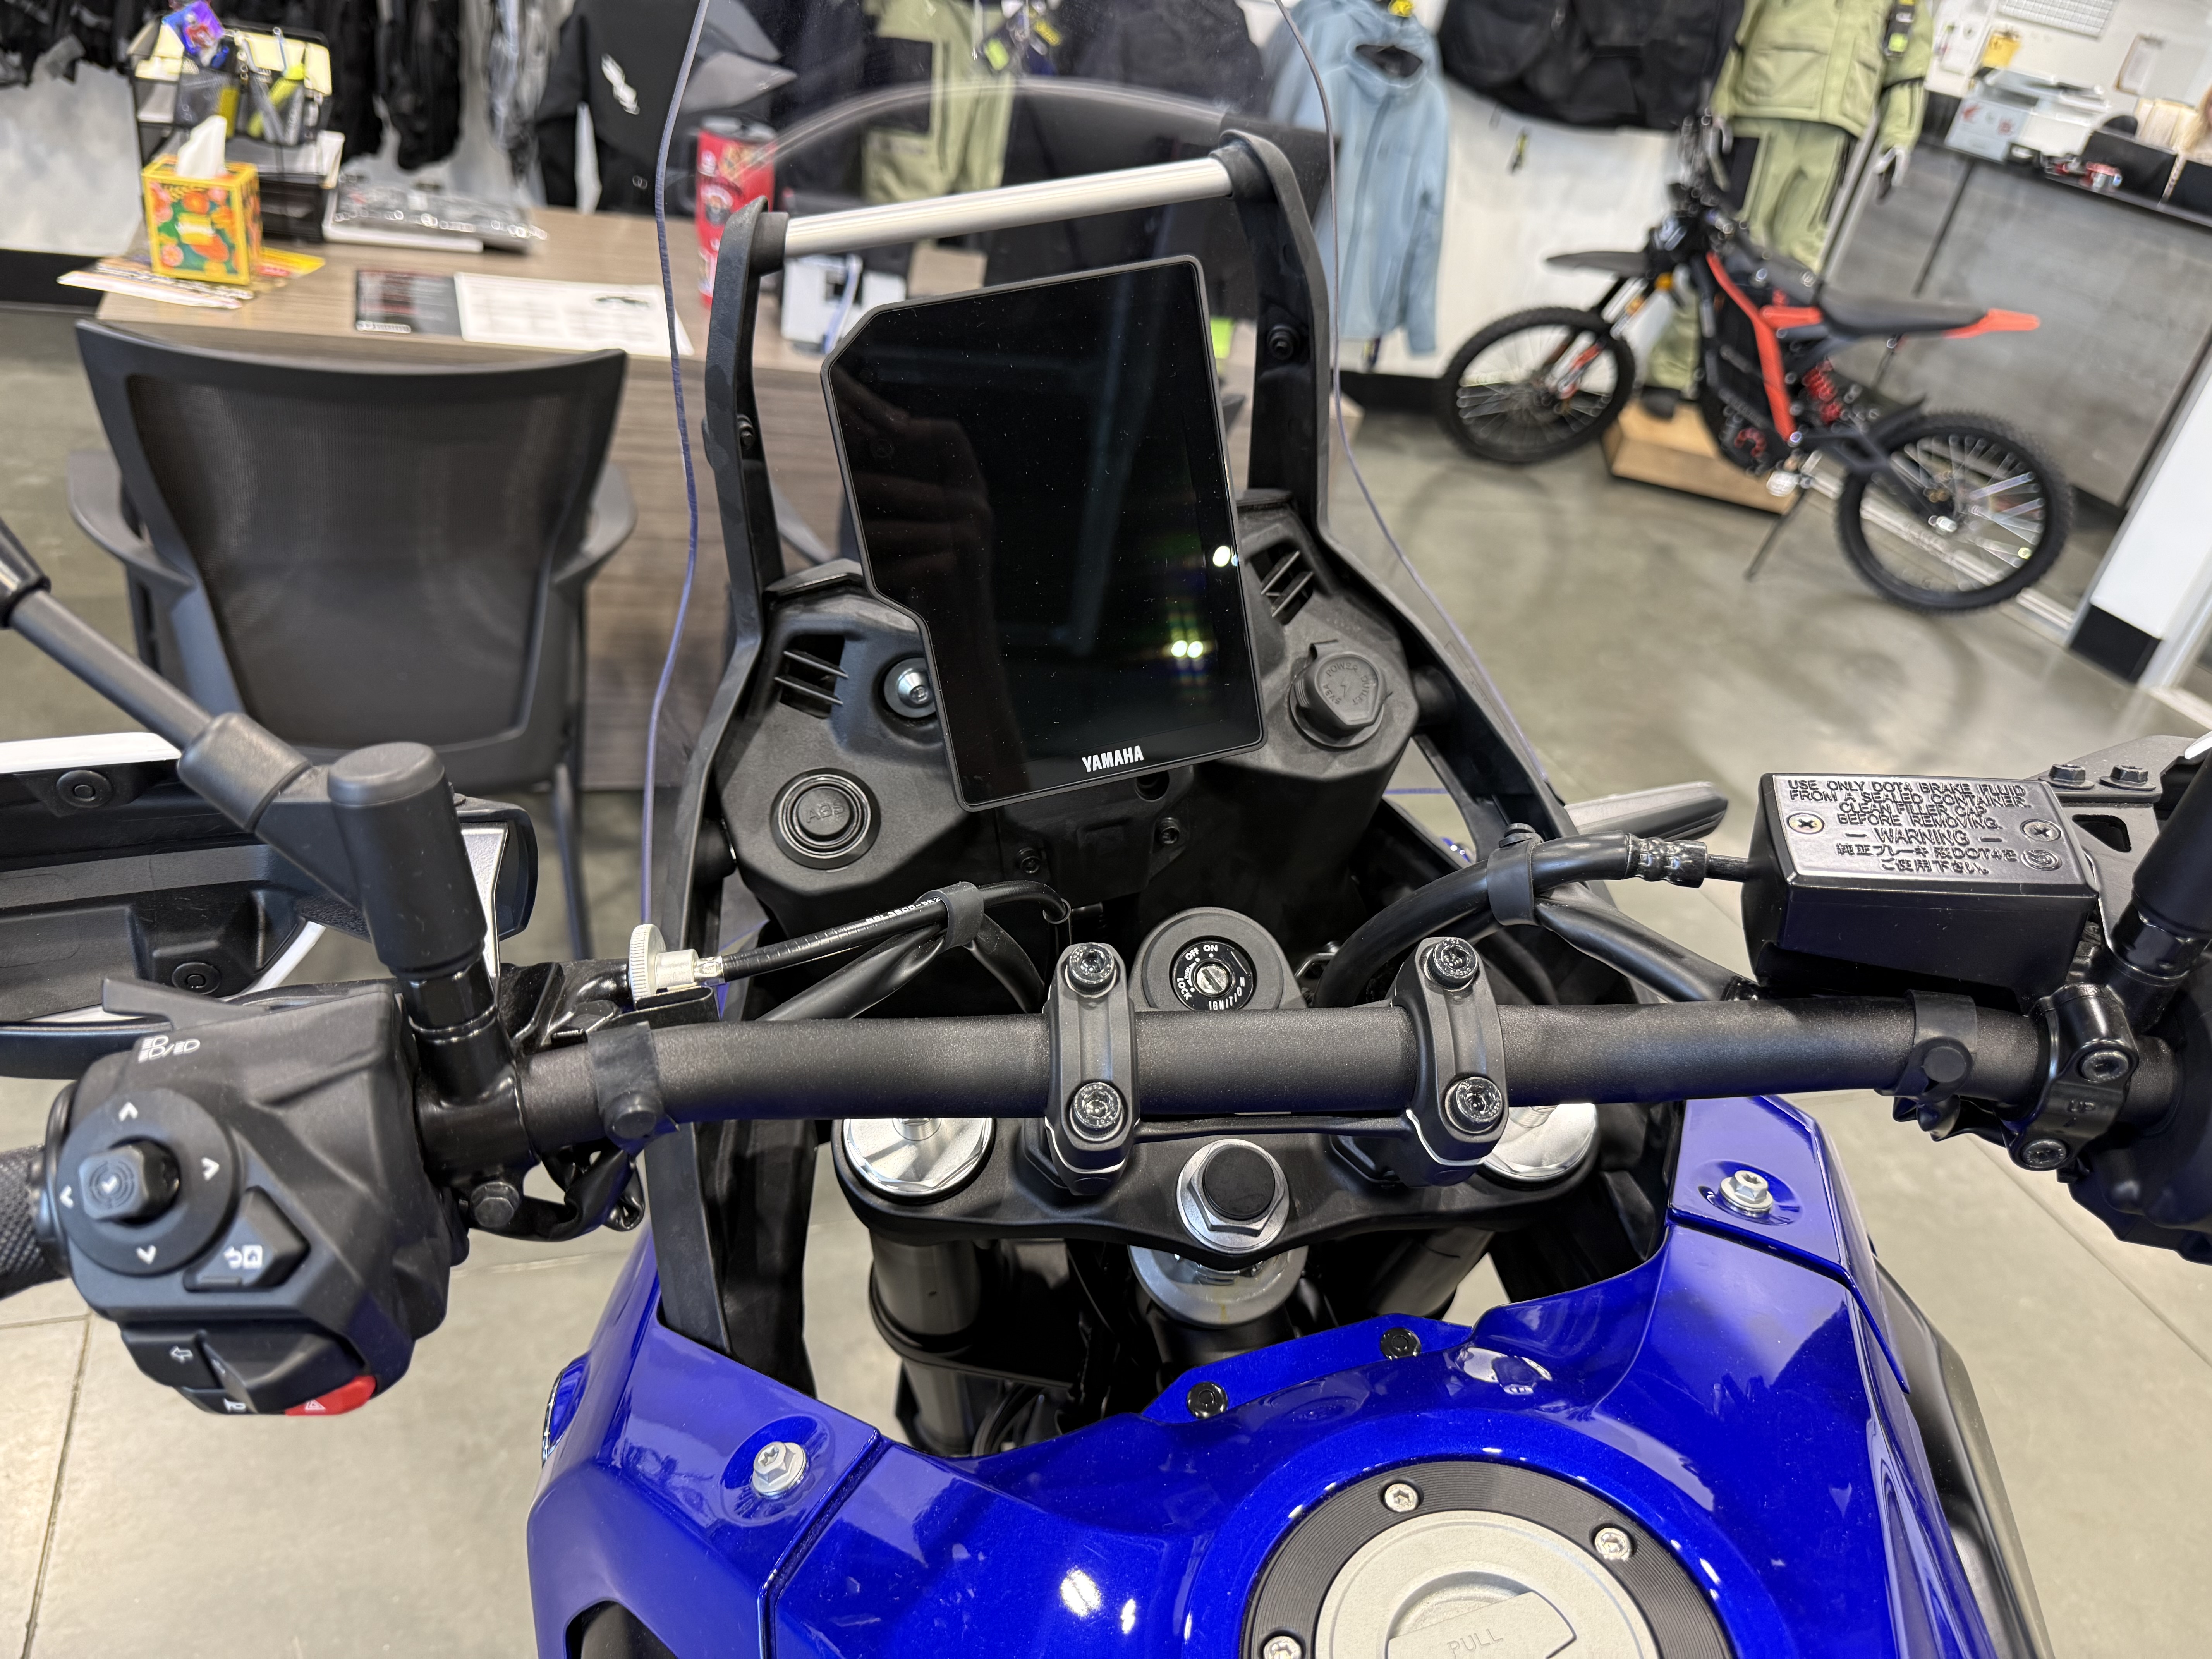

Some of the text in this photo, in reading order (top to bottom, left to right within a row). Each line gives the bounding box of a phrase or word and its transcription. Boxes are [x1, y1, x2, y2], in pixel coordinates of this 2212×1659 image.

[1082, 745, 1144, 772] YAMAHA
[1788, 780, 2026, 796] USE ONLY DOT4 BRAKE FLUID
[1790, 790, 2032, 808] FROM A SEALED CONTAINER.
[806, 797, 845, 824] ABS
[1839, 802, 1987, 817] CLEAN FILLER CAP
[1837, 813, 2003, 830] BEFORE REMOVING.
[1874, 828, 1970, 846] WARNING
[1185, 947, 1199, 960] OFF
[1177, 977, 1192, 1000] LOCK
[1209, 977, 1245, 1011] IGNITION
[1446, 1628, 1504, 1659] PULL
